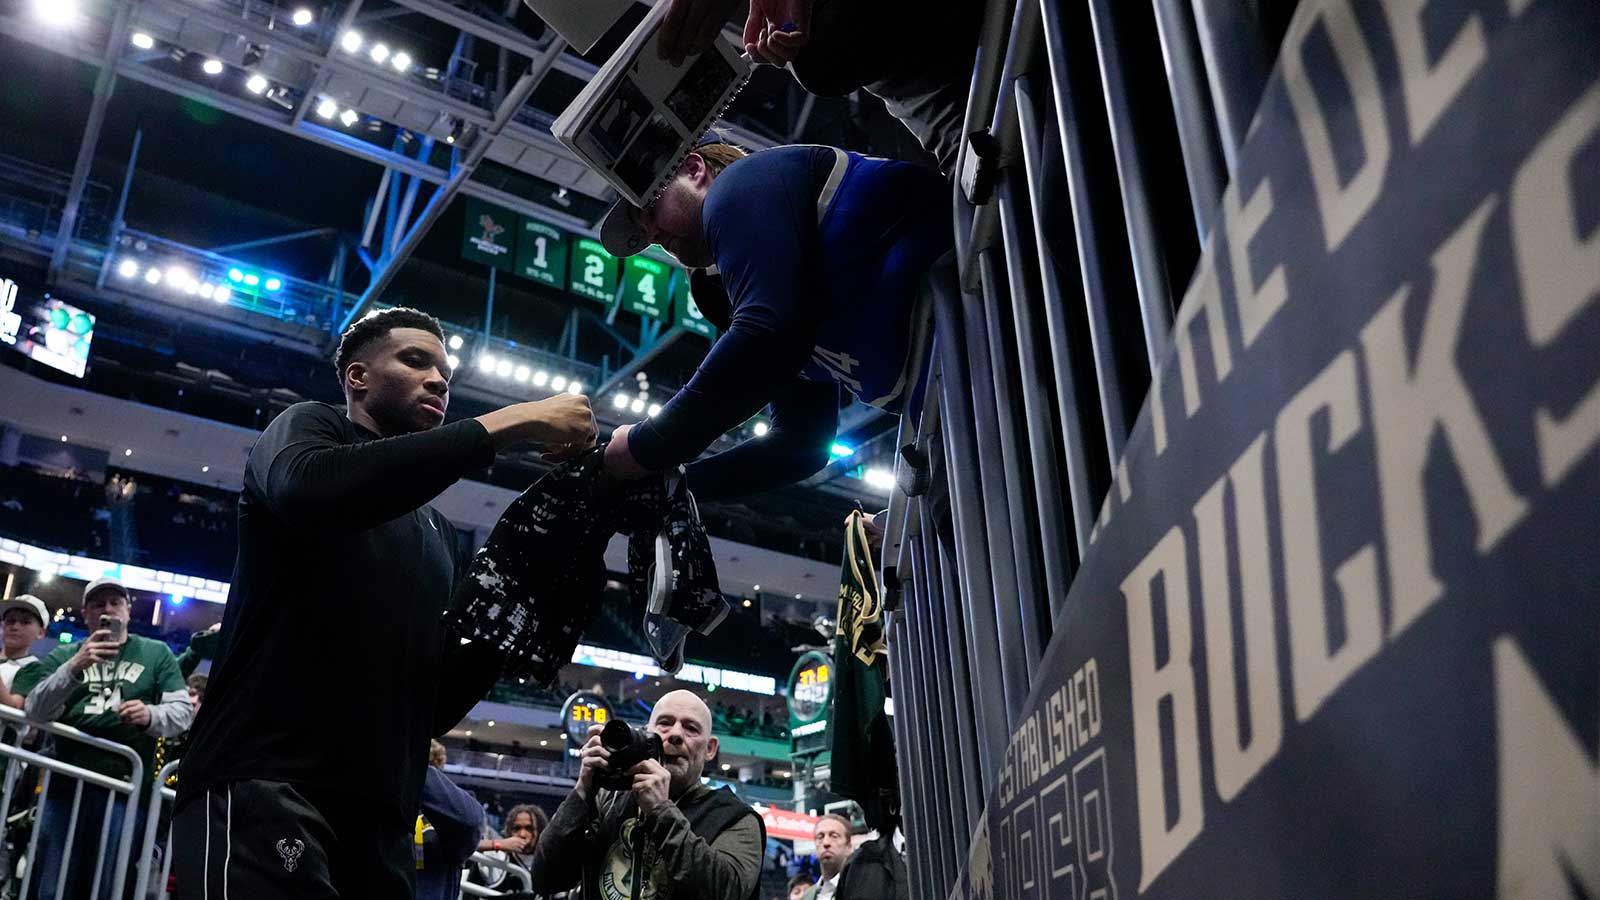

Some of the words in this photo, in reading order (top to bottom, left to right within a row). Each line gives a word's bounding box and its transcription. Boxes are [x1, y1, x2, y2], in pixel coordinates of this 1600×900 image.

[533, 236, 548, 269] 1
[583, 254, 605, 287] 2
[637, 273, 657, 304] 4
[1120, 76, 1600, 895] BUCKS
